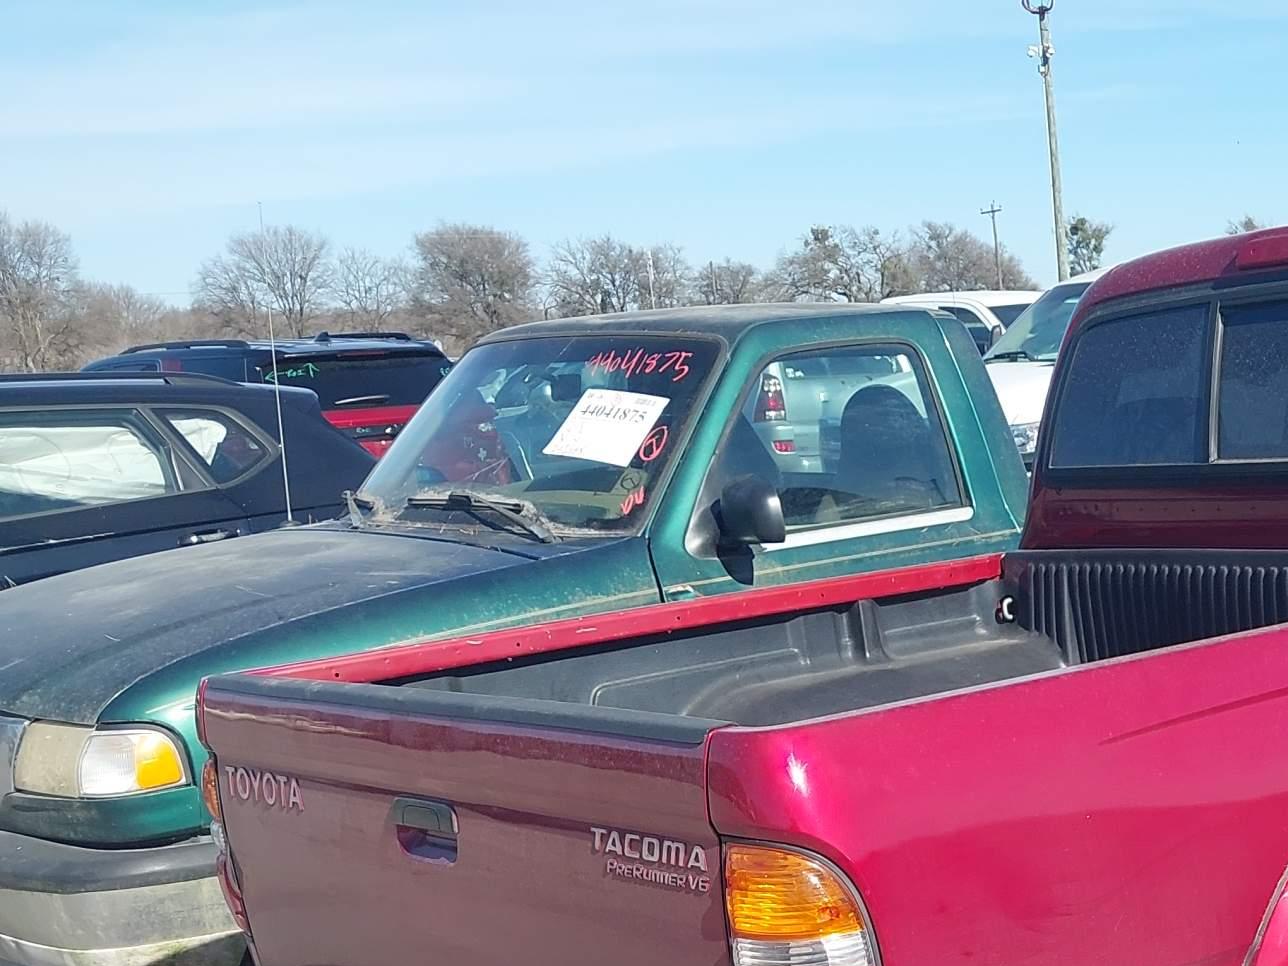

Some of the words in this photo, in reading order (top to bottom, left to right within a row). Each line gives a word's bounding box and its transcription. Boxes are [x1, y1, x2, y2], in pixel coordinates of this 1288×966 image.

[580, 404, 647, 423] 44041875
[224, 766, 304, 811] TOYOTA
[590, 826, 708, 872] TACOMA
[688, 873, 711, 892] V6
